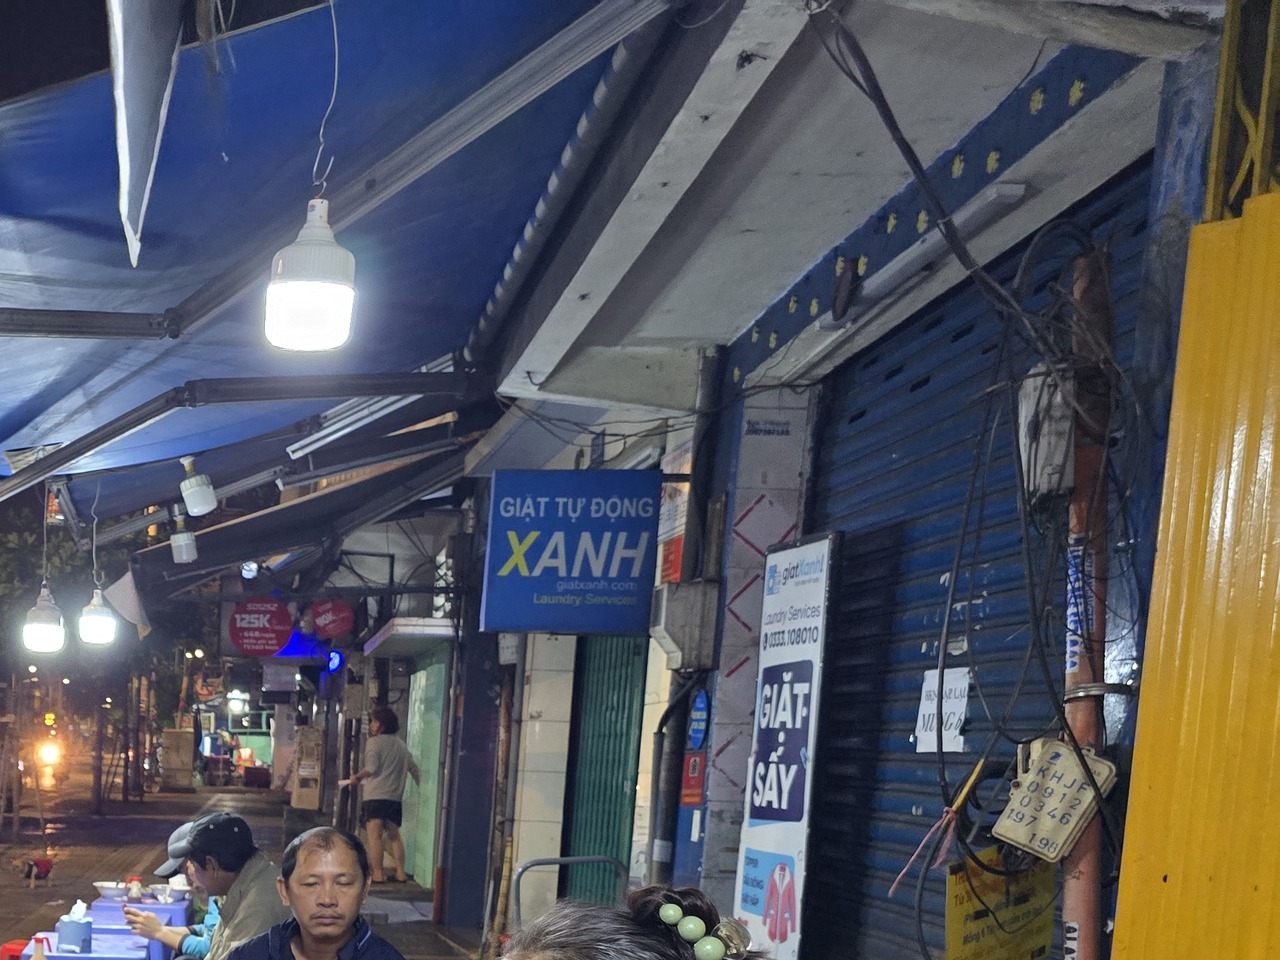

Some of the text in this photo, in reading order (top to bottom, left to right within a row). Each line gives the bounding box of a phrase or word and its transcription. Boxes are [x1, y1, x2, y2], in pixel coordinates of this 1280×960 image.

[554, 496, 587, 523] TỰ
[496, 530, 650, 578] XANH
[533, 593, 580, 607] Laundry
[234, 613, 271, 628] 125K
[763, 603, 822, 626] Laundry Services
[768, 625, 819, 648] 0333.108010
[752, 746, 798, 810] SẤY
[1026, 780, 1082, 810] 0912
[1006, 808, 1038, 827] 197
[1019, 794, 1072, 825] 0346
[1027, 832, 1059, 854] 198
